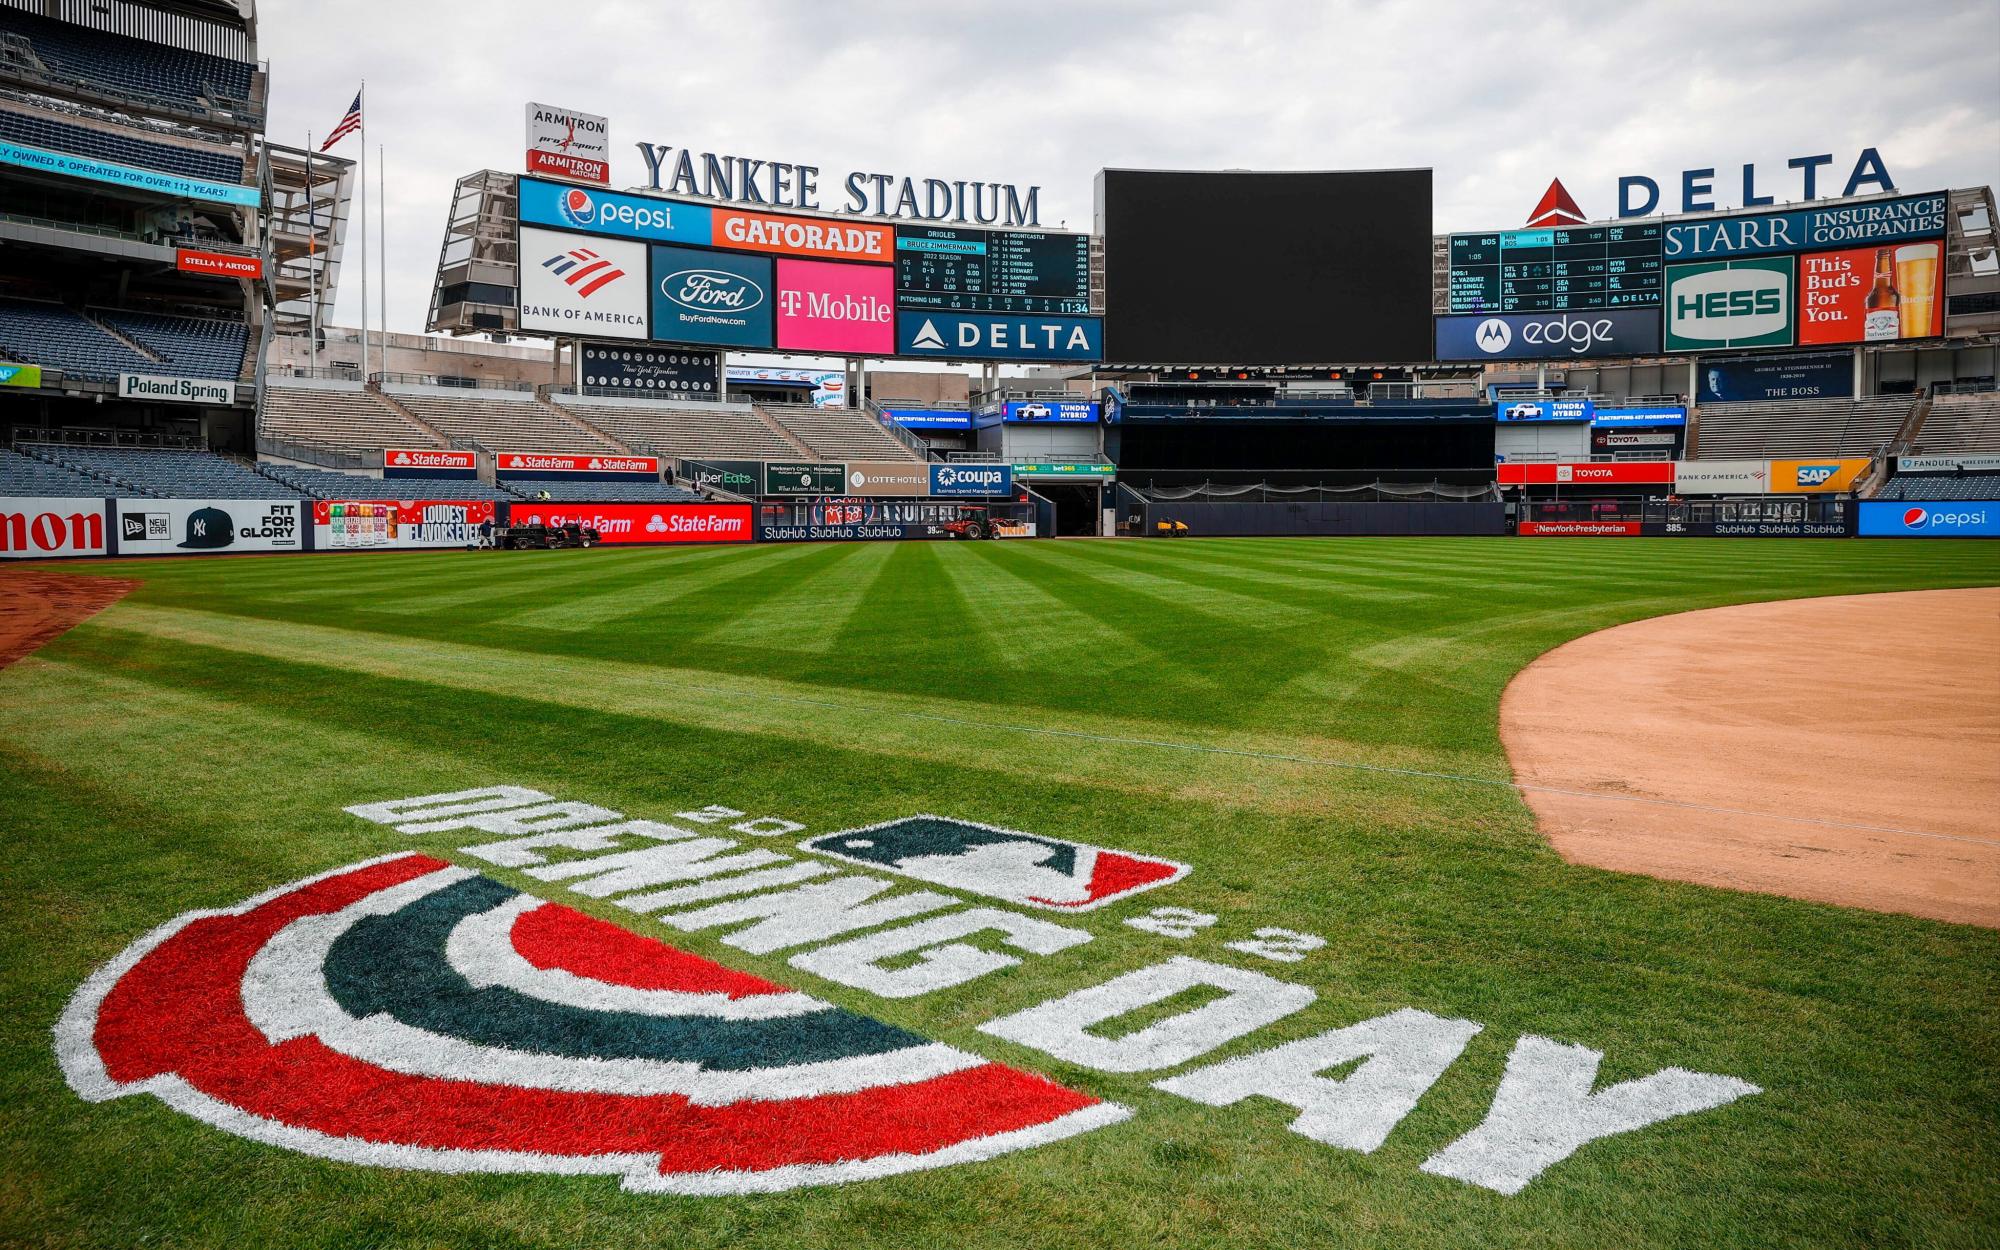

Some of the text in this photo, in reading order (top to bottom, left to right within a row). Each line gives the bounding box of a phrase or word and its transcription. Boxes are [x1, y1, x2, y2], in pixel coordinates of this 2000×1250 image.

[535, 111, 605, 133] ARMITRON
[538, 155, 602, 173] ARMITRON
[13, 151, 54, 165] OWNED
[69, 162, 120, 178] OPERATED
[124, 172, 143, 182] FOR
[146, 177, 170, 187] OVER
[174, 182, 190, 191] 112
[193, 185, 228, 197] YEARS!
[570, 169, 600, 179] WATCHES
[636, 141, 1041, 227] YANKEE STADIUM
[1619, 148, 1895, 218] DELTA
[600, 202, 672, 230] pepsi
[1665, 198, 1946, 256] STARR INSURANCE
[1814, 214, 1946, 243] COMPANIES
[725, 217, 882, 254] GATORADE
[906, 240, 976, 251] BRUCE ZIMMERMANN
[185, 257, 255, 271] STELLA ARTOIS
[1806, 257, 1851, 274] This
[1806, 272, 1860, 290] Bud's
[679, 274, 744, 308] Ford
[1623, 294, 1658, 302] DELTA
[1677, 288, 1780, 320] HESS
[1806, 292, 1839, 306] For
[807, 291, 891, 323] Mobile
[1060, 303, 1088, 313] 11:34
[523, 305, 644, 326] BANK OF AMERICA
[679, 313, 746, 326] BuyFordNow.com
[1806, 308, 1848, 323] You.
[958, 322, 1090, 350] DELTA
[1523, 314, 1613, 353] edge
[622, 364, 678, 377] New York Yankees
[127, 376, 227, 402] Poland Spring
[1765, 386, 1820, 396] THE BOSS
[695, 471, 751, 484] Uber Eats
[896, 476, 927, 484] HOTELS
[957, 471, 1002, 486] coupa
[1576, 469, 1613, 477] TOYOTA
[1798, 470, 1831, 483] SAP
[271, 505, 294, 515] FIT
[422, 505, 468, 523] LOUDEST
[261, 516, 295, 526] FOR
[1932, 510, 1986, 527] pepsi
[240, 527, 295, 538] GLORY
[410, 523, 455, 541] FLAVORS
[765, 527, 806, 538] StubHub
[809, 527, 853, 538] StubHub
[857, 526, 901, 537] StubHub
[1666, 524, 1682, 532] 385
[1715, 525, 1756, 534] StubHub
[1759, 525, 1800, 534] StubHub
[1803, 525, 1845, 534] StubHub
[343, 785, 1094, 998] OPENING
[976, 955, 1763, 1195] DAY
